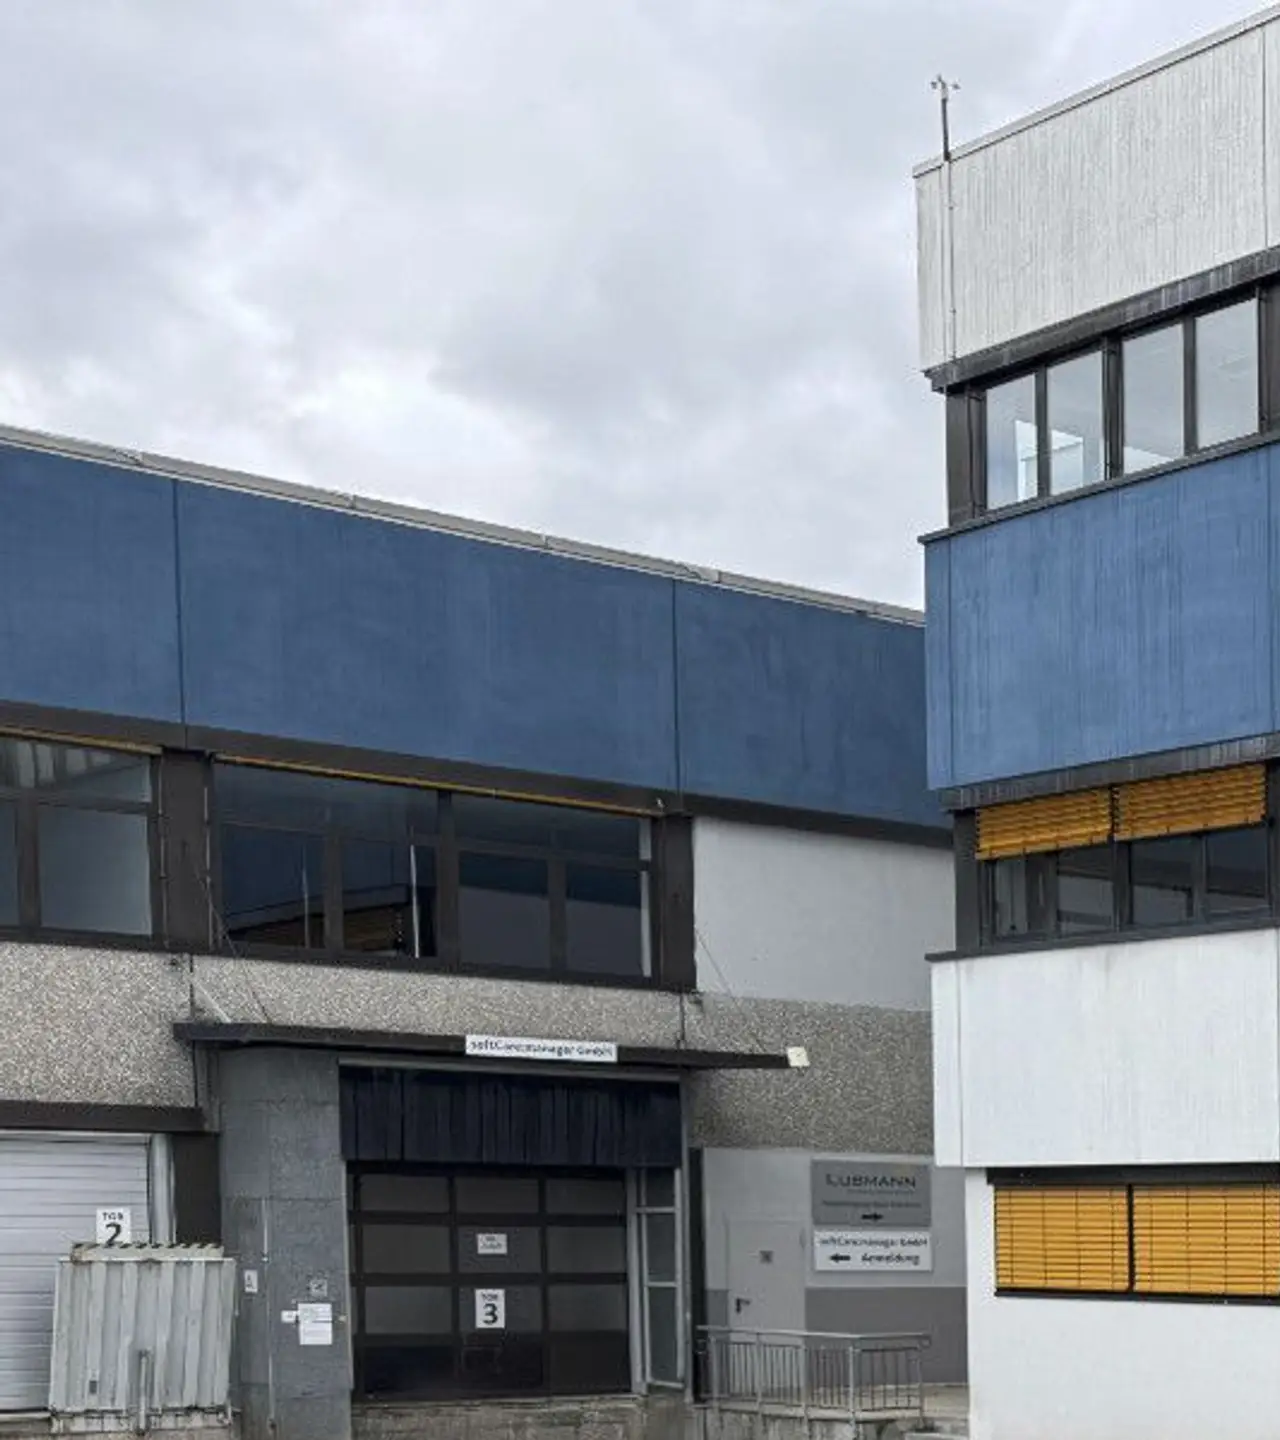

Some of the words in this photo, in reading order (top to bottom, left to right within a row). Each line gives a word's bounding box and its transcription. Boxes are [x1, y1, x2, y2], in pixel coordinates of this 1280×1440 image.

[825, 1173, 917, 1189] LUBMANN
[104, 1222, 122, 1249] 2
[482, 1303, 499, 1326] 3
